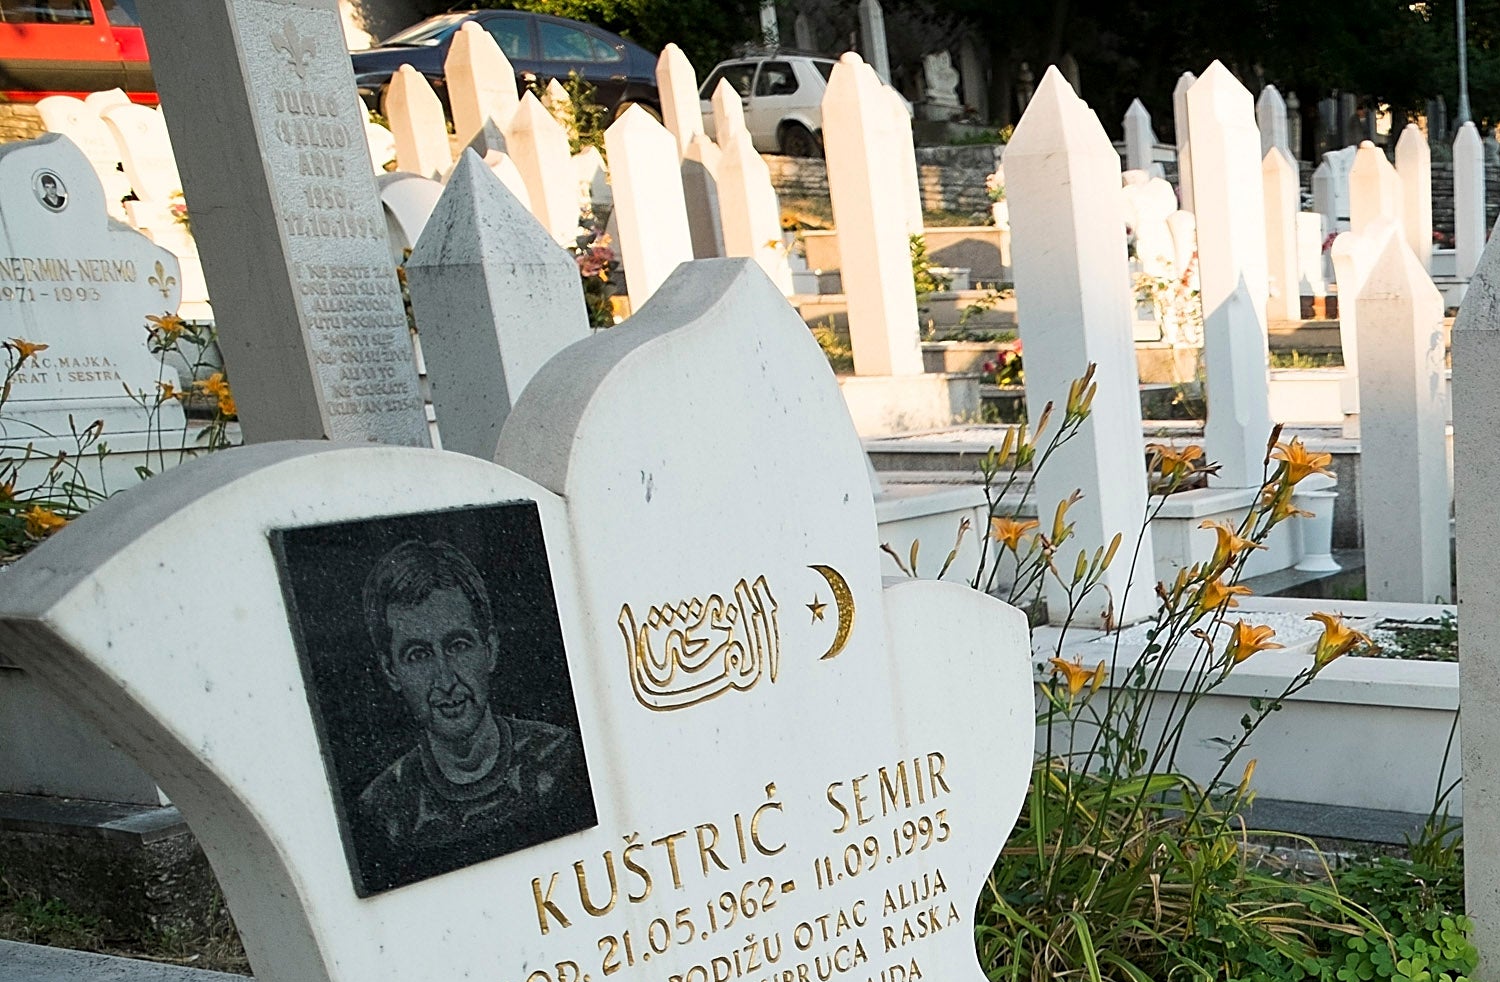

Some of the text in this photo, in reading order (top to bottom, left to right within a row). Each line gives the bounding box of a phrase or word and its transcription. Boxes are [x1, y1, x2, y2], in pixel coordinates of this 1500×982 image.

[299, 151, 346, 178] ARIF
[67, 370, 122, 383] SESTRA
[531, 751, 951, 935] KUŠTRIĆ SEMIR
[814, 808, 951, 890] 11.09.1993
[793, 899, 867, 951] OTAC
[883, 868, 948, 918] ALIJA
[882, 901, 961, 954] RASKA
